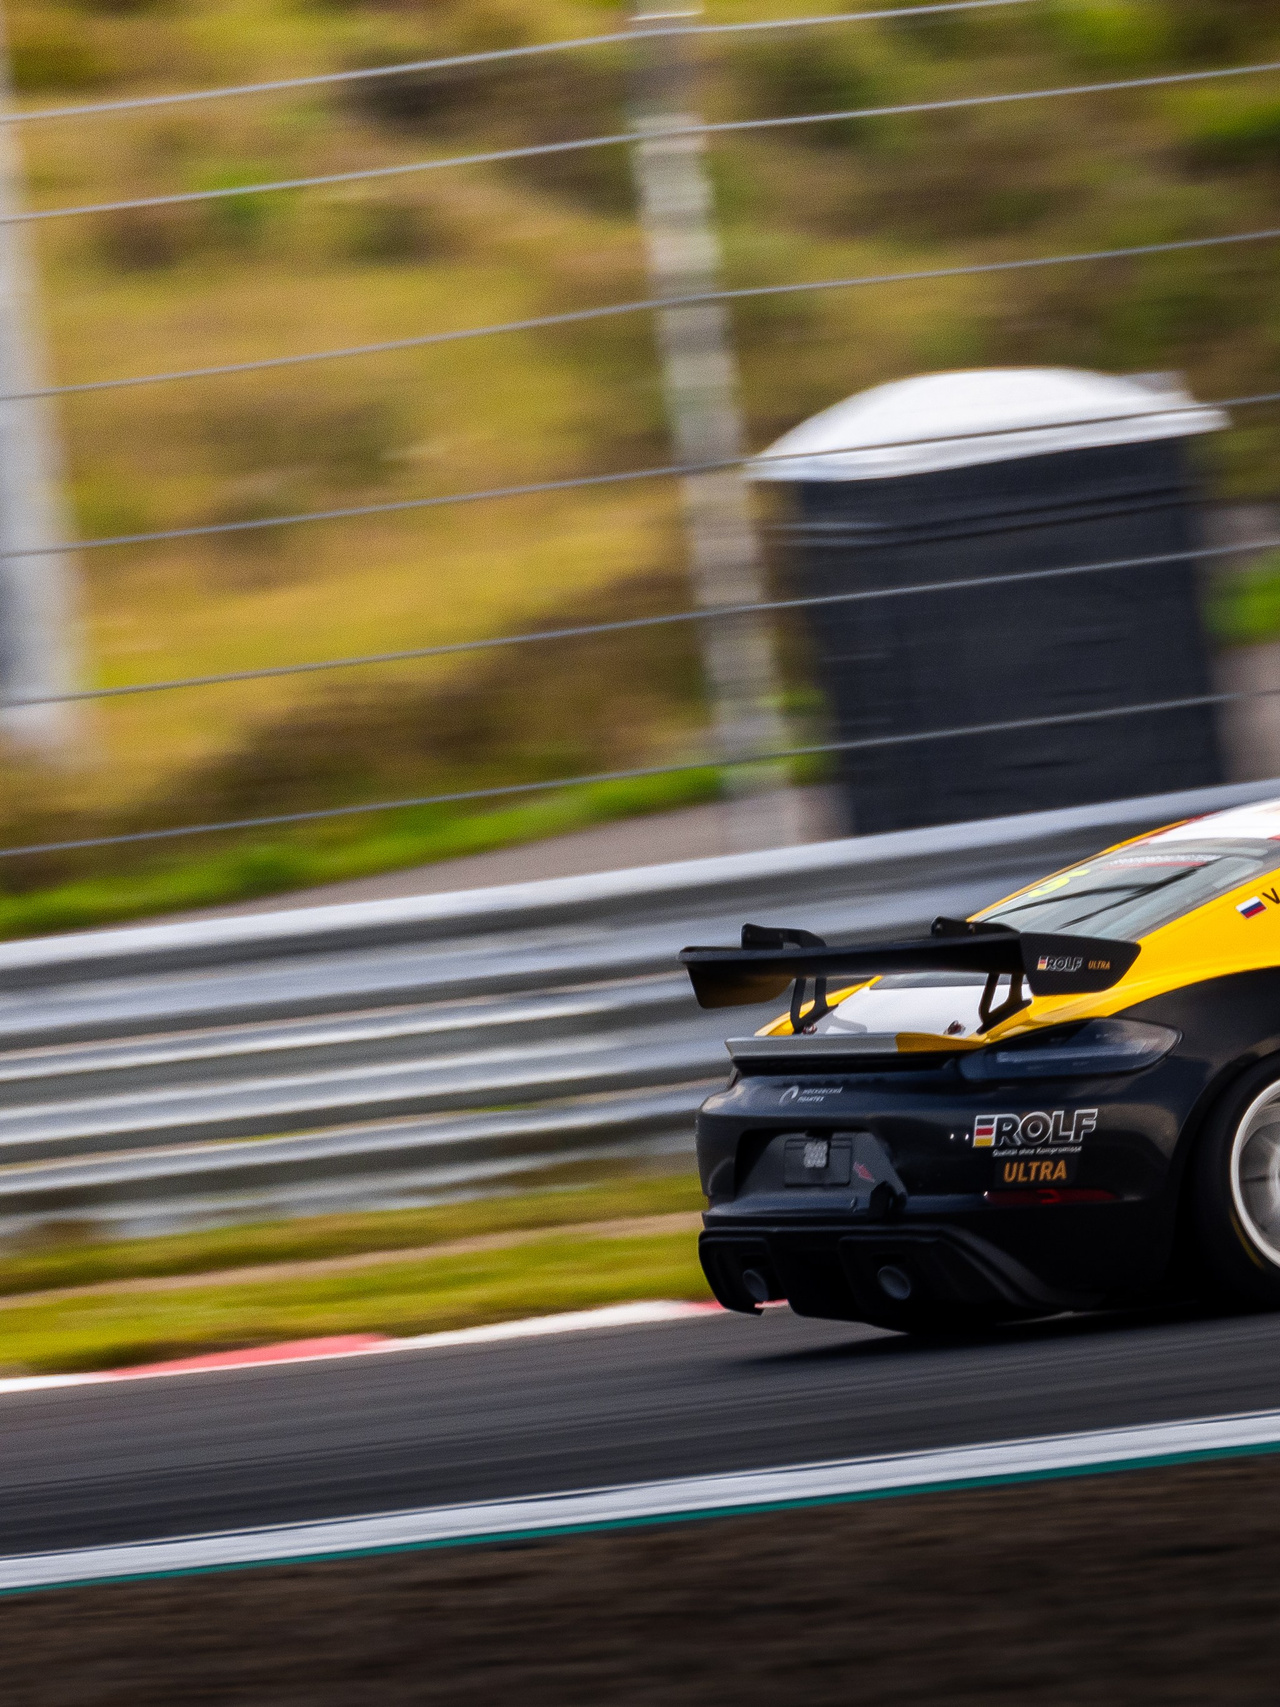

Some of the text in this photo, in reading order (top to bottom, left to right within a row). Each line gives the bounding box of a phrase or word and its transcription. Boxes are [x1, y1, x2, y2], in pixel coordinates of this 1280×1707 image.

[1046, 956, 1111, 972] ROLF ULTRA
[994, 1108, 1098, 1146] ROLF
[1003, 1160, 1067, 1182] ULTRA
